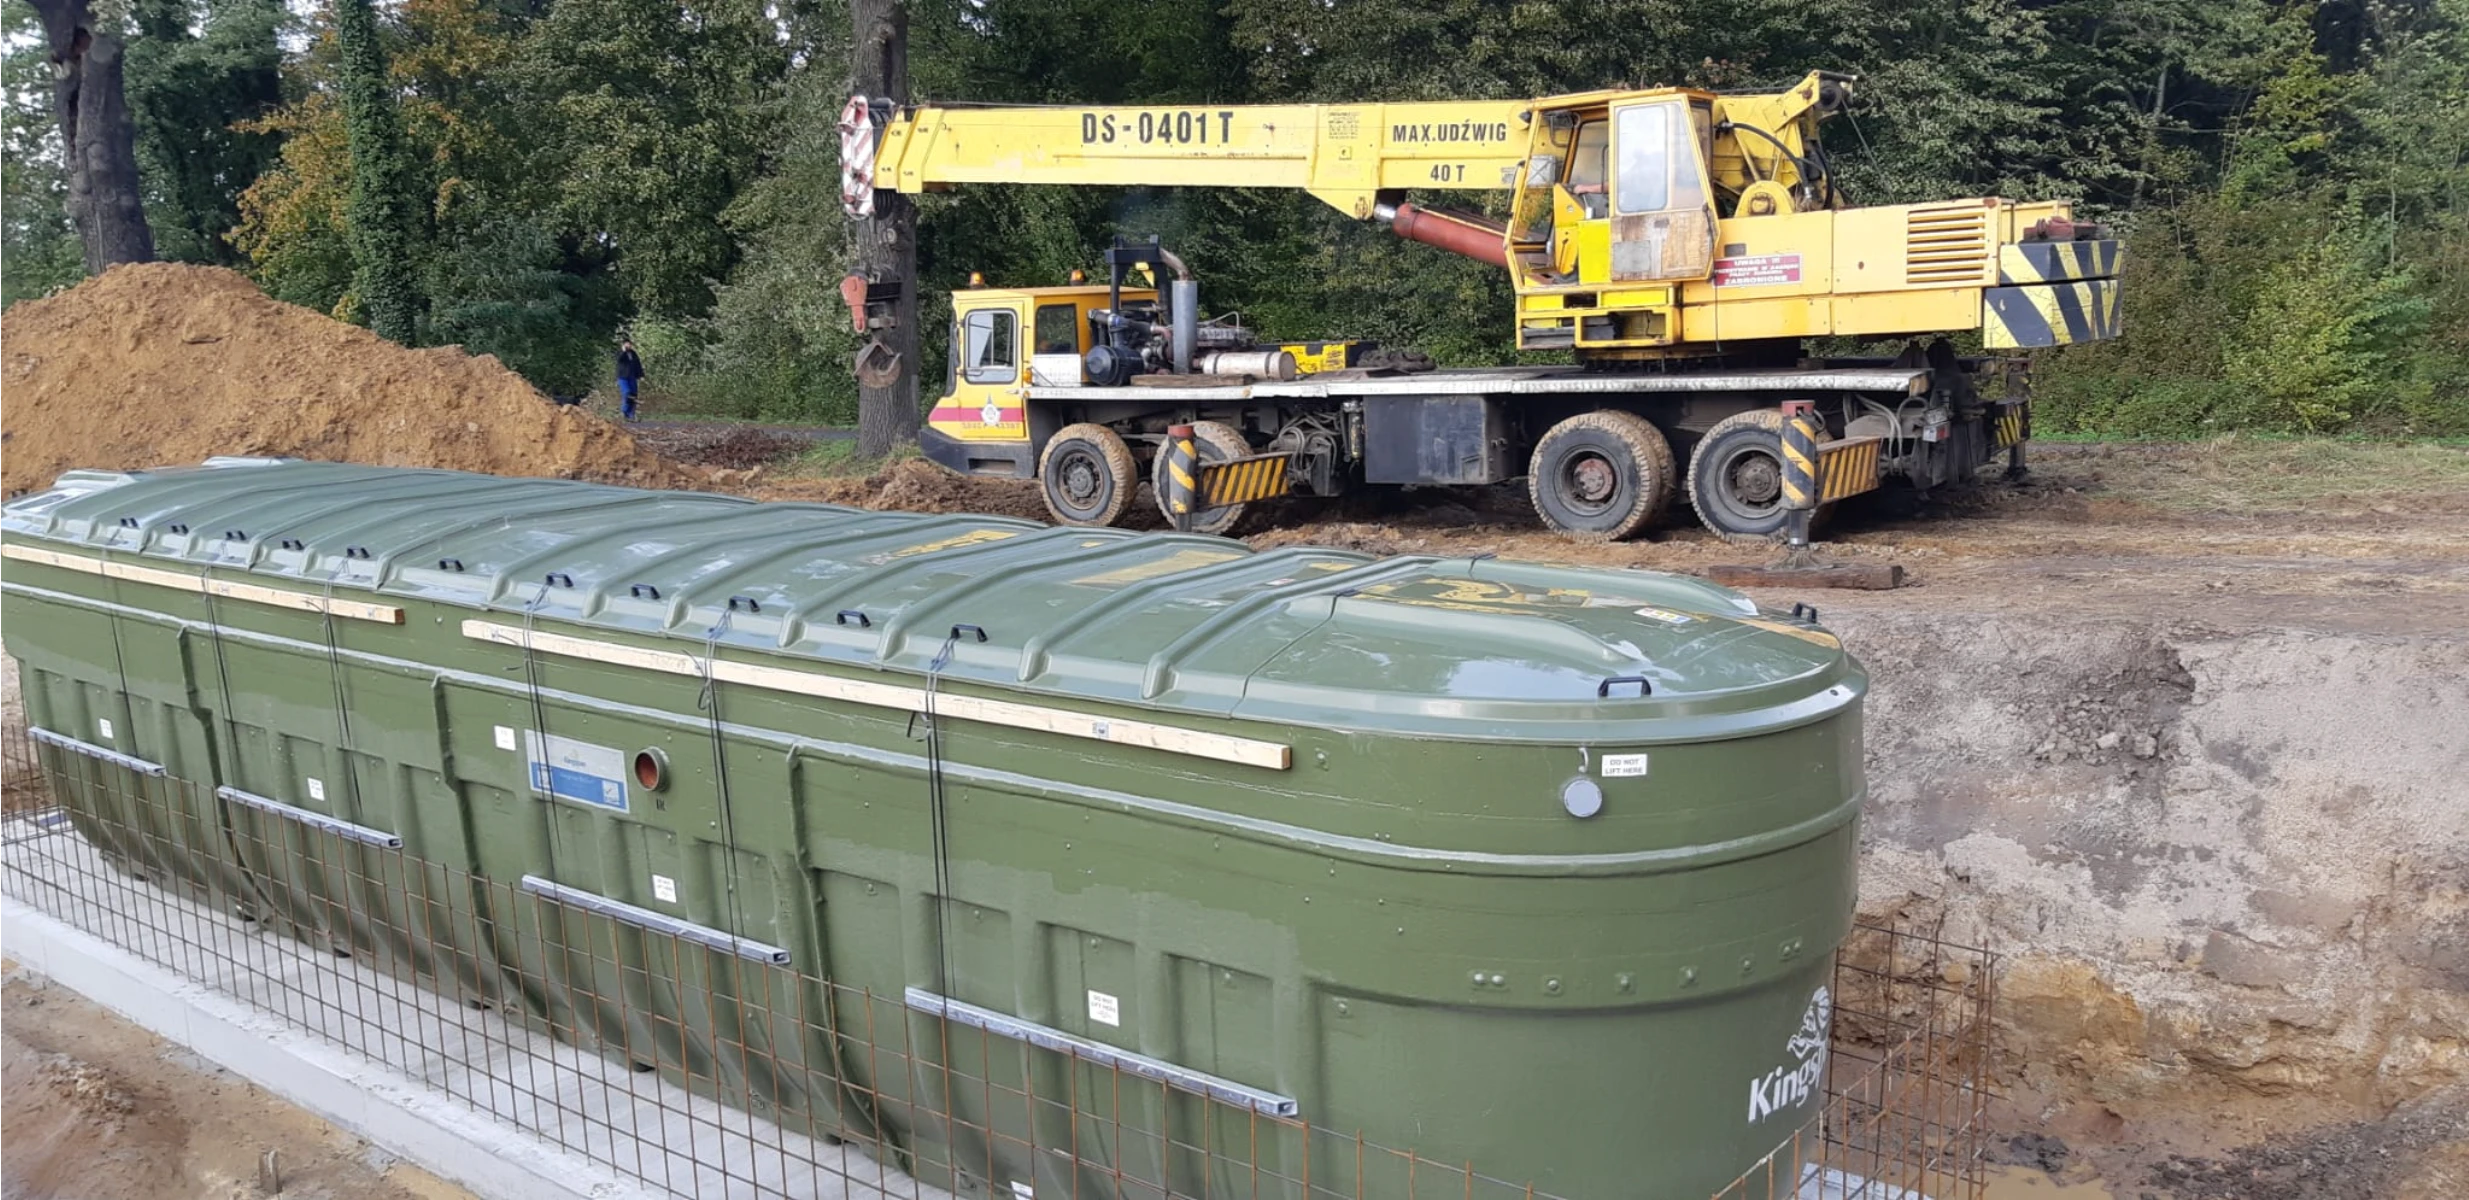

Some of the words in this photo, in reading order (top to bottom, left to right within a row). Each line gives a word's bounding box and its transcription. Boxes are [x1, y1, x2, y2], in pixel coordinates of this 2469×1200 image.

[1218, 111, 1234, 143] T
[1392, 118, 1507, 142] MAX.UDŹWIG
[1430, 164, 1451, 182] 40
[1456, 164, 1466, 182] T
[1605, 767, 1621, 775] LIFT
[1623, 766, 1643, 774] HERE
[1623, 758, 1640, 766] NOT
